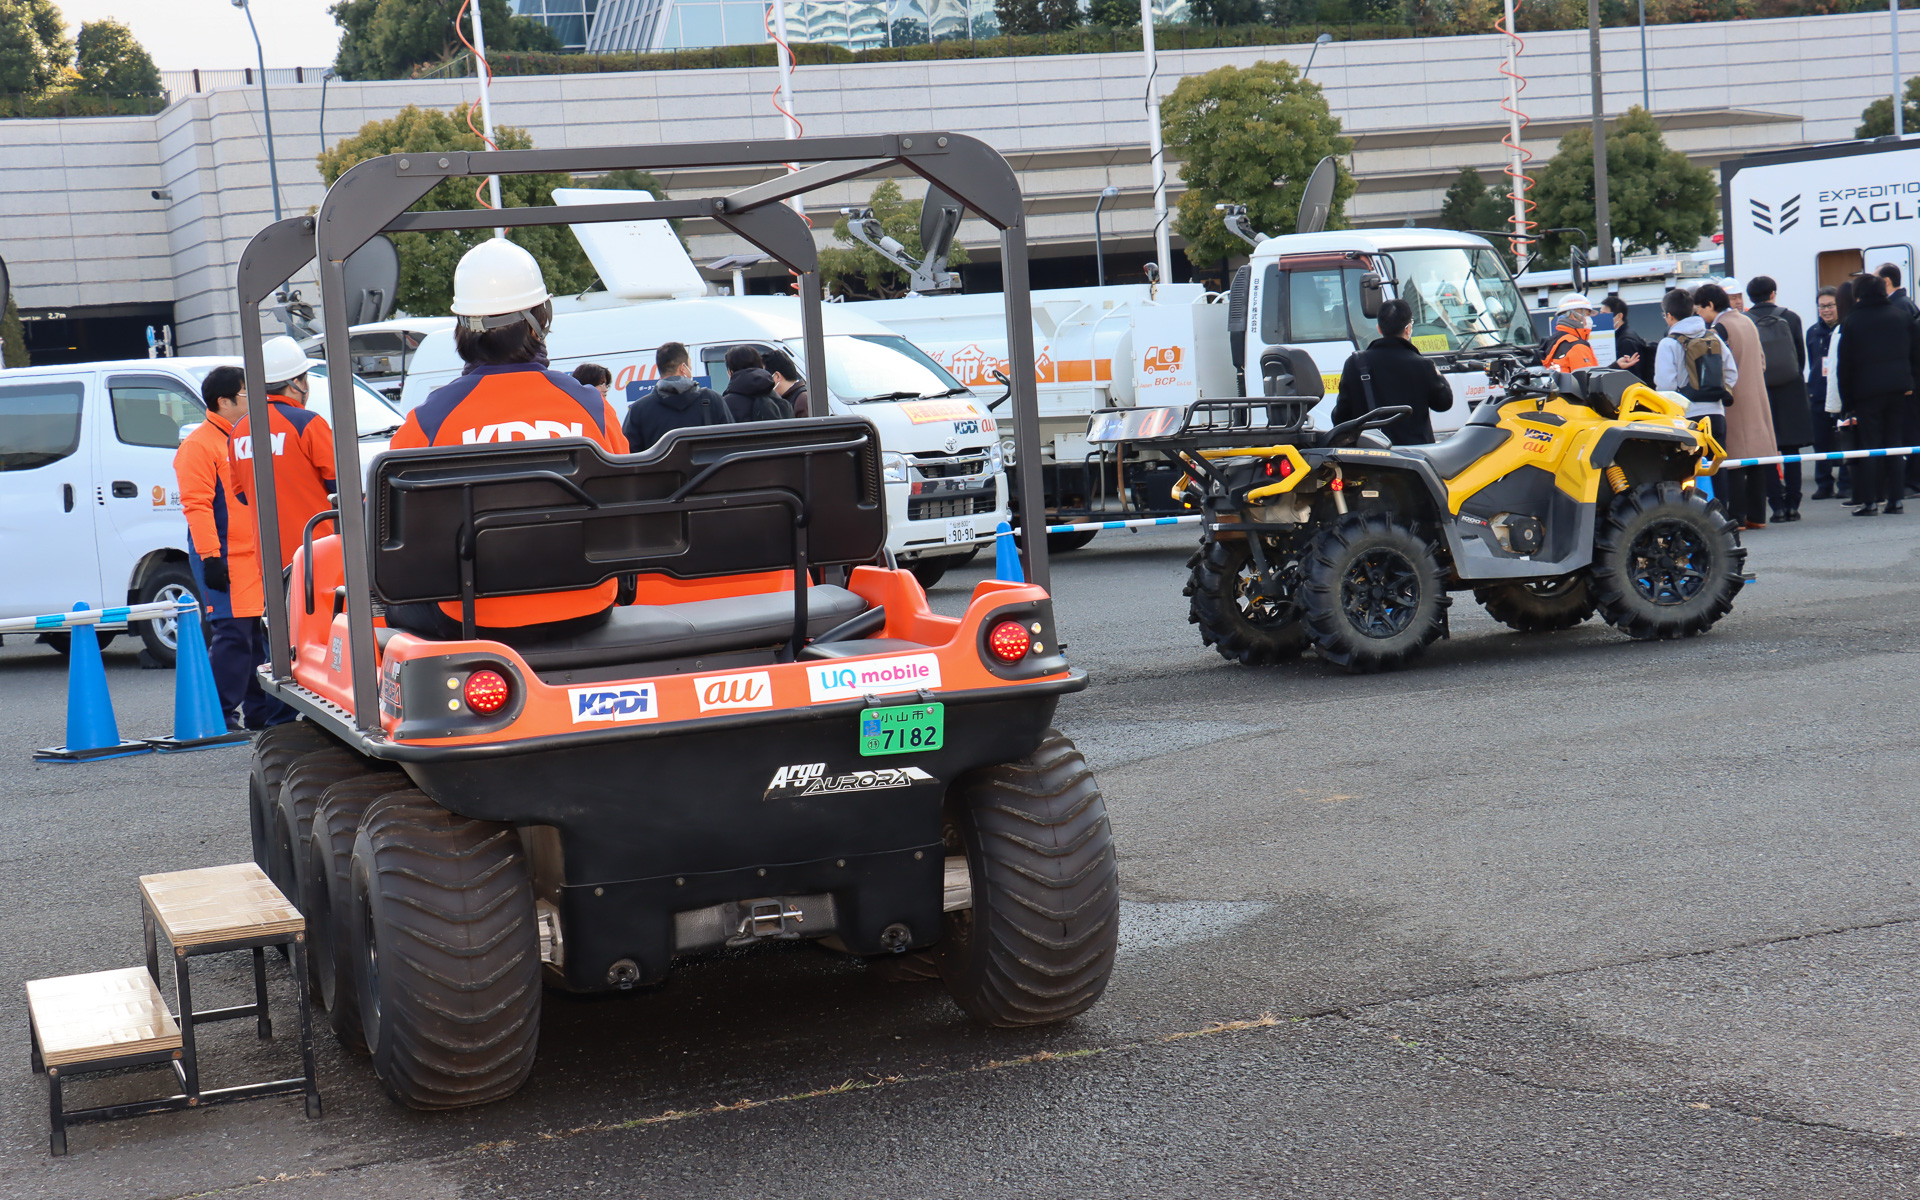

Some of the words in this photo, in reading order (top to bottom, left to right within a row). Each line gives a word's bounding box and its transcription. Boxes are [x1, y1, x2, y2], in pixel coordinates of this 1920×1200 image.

[1819, 181, 1920, 202] EXPEDITIO
[1820, 200, 1920, 228] EAGL
[1251, 278, 1259, 333] 日本BCP株式会社
[47, 312, 67, 320] 2.7m
[1154, 377, 1176, 386] BCP
[1466, 385, 1486, 396] Japan
[954, 420, 979, 434] KDDI
[1524, 428, 1553, 442] KDDI
[1523, 441, 1547, 453] au
[1461, 516, 1487, 526] 1000R
[952, 528, 974, 542] 90-90
[821, 668, 856, 689] UQ
[861, 664, 930, 684] mobile
[704, 678, 764, 704] au
[579, 688, 648, 716] KDDI
[881, 711, 924, 723] 小山市
[882, 726, 936, 749] 7182
[768, 762, 826, 790] Argo
[802, 772, 911, 796] AURORA
